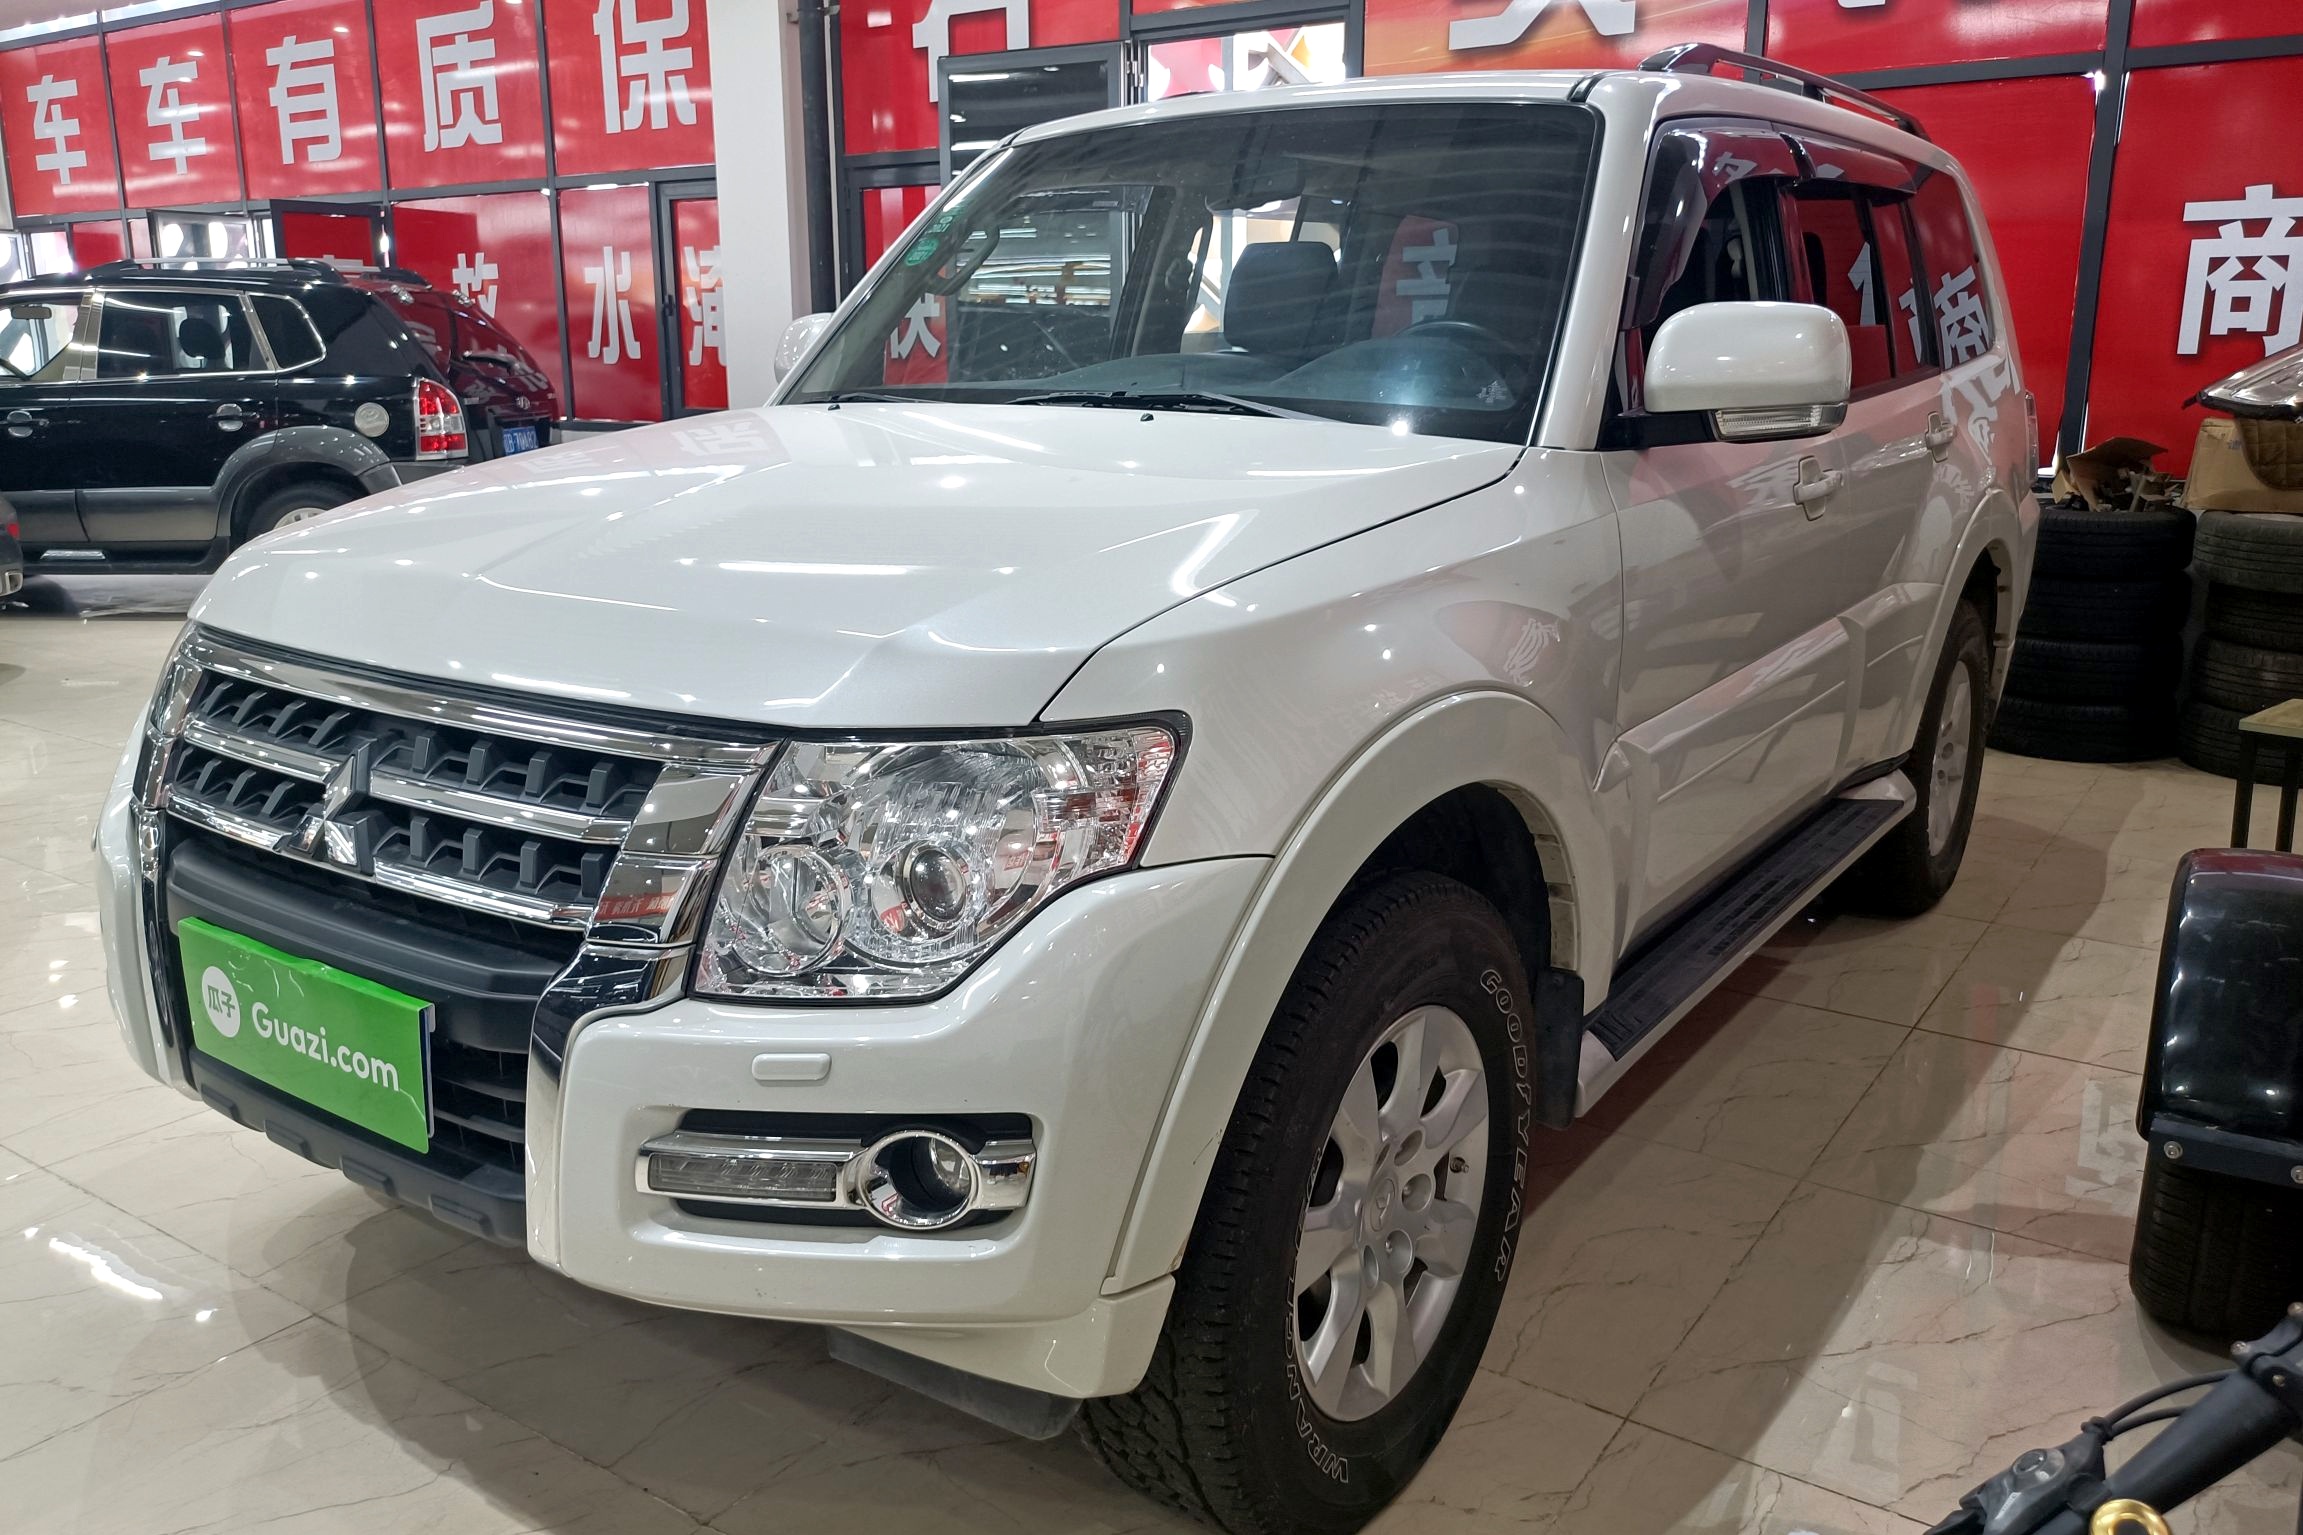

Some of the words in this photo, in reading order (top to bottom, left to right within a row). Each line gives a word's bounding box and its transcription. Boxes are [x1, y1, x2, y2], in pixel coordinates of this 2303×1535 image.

[27, 0, 698, 185] 车车有质保
[207, 984, 236, 1019] 瓜子
[252, 1001, 400, 1091] Guazi.com
[1480, 968, 1532, 1282] GOODYEAR
